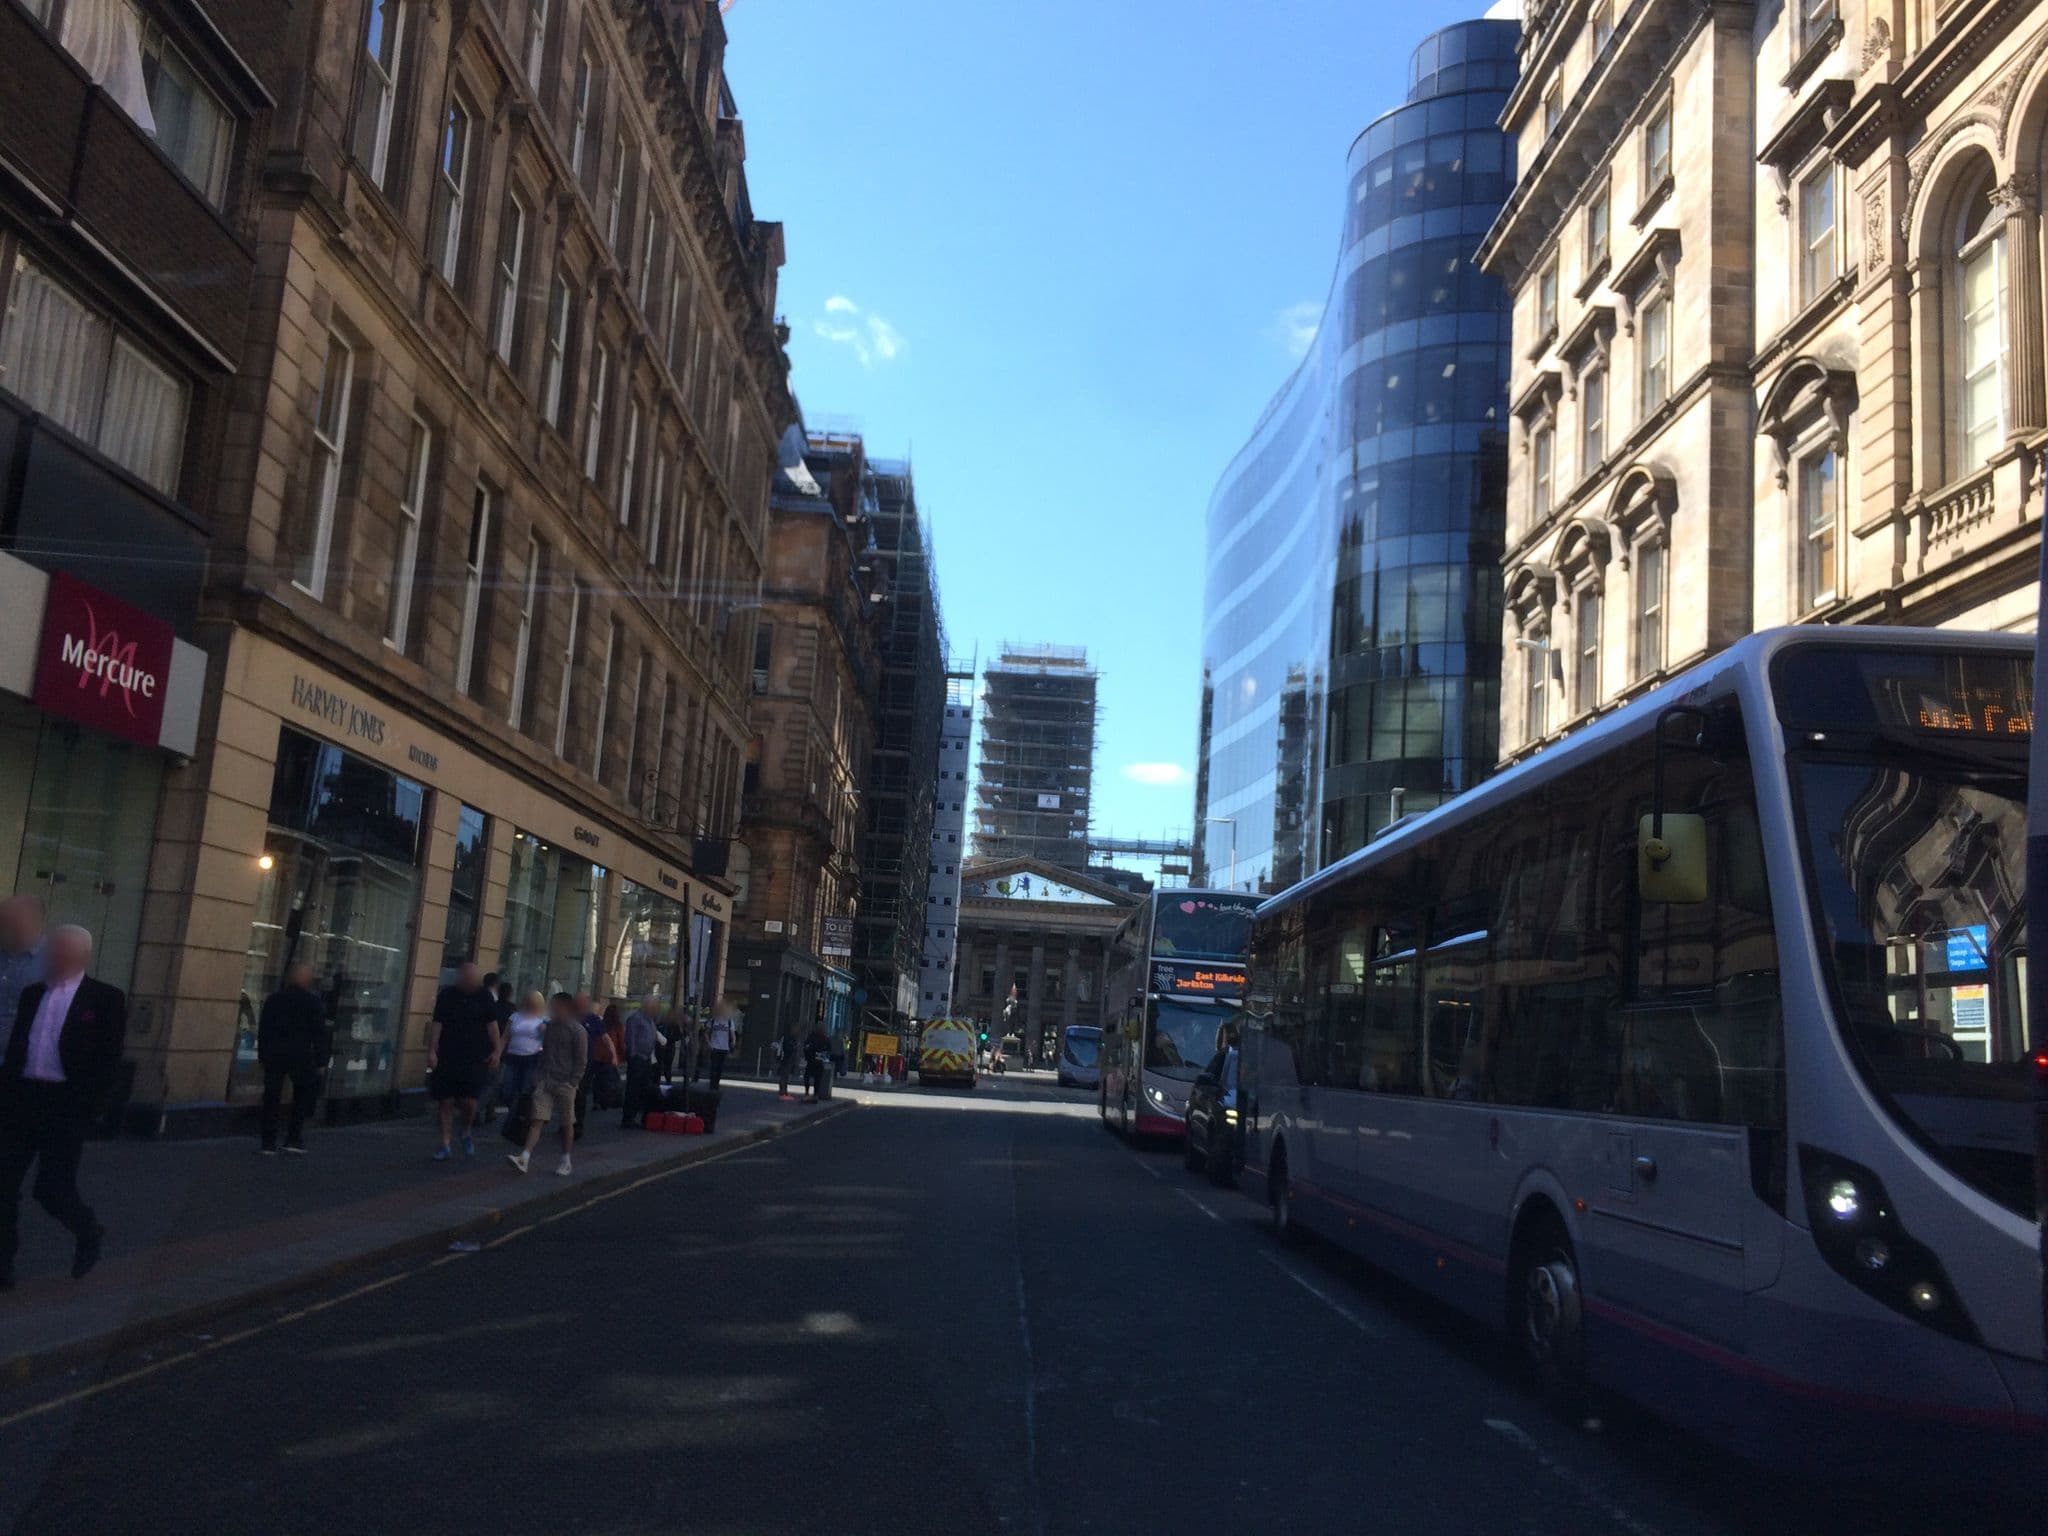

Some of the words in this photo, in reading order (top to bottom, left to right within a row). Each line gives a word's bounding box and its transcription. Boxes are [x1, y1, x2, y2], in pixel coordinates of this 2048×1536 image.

[61, 633, 156, 698] Mercure
[292, 674, 348, 727] HARVEY
[347, 704, 386, 746] JONES
[824, 922, 837, 931] TO
[838, 924, 853, 932] LET
[1157, 964, 1174, 973] free
[1195, 971, 1214, 981] East
